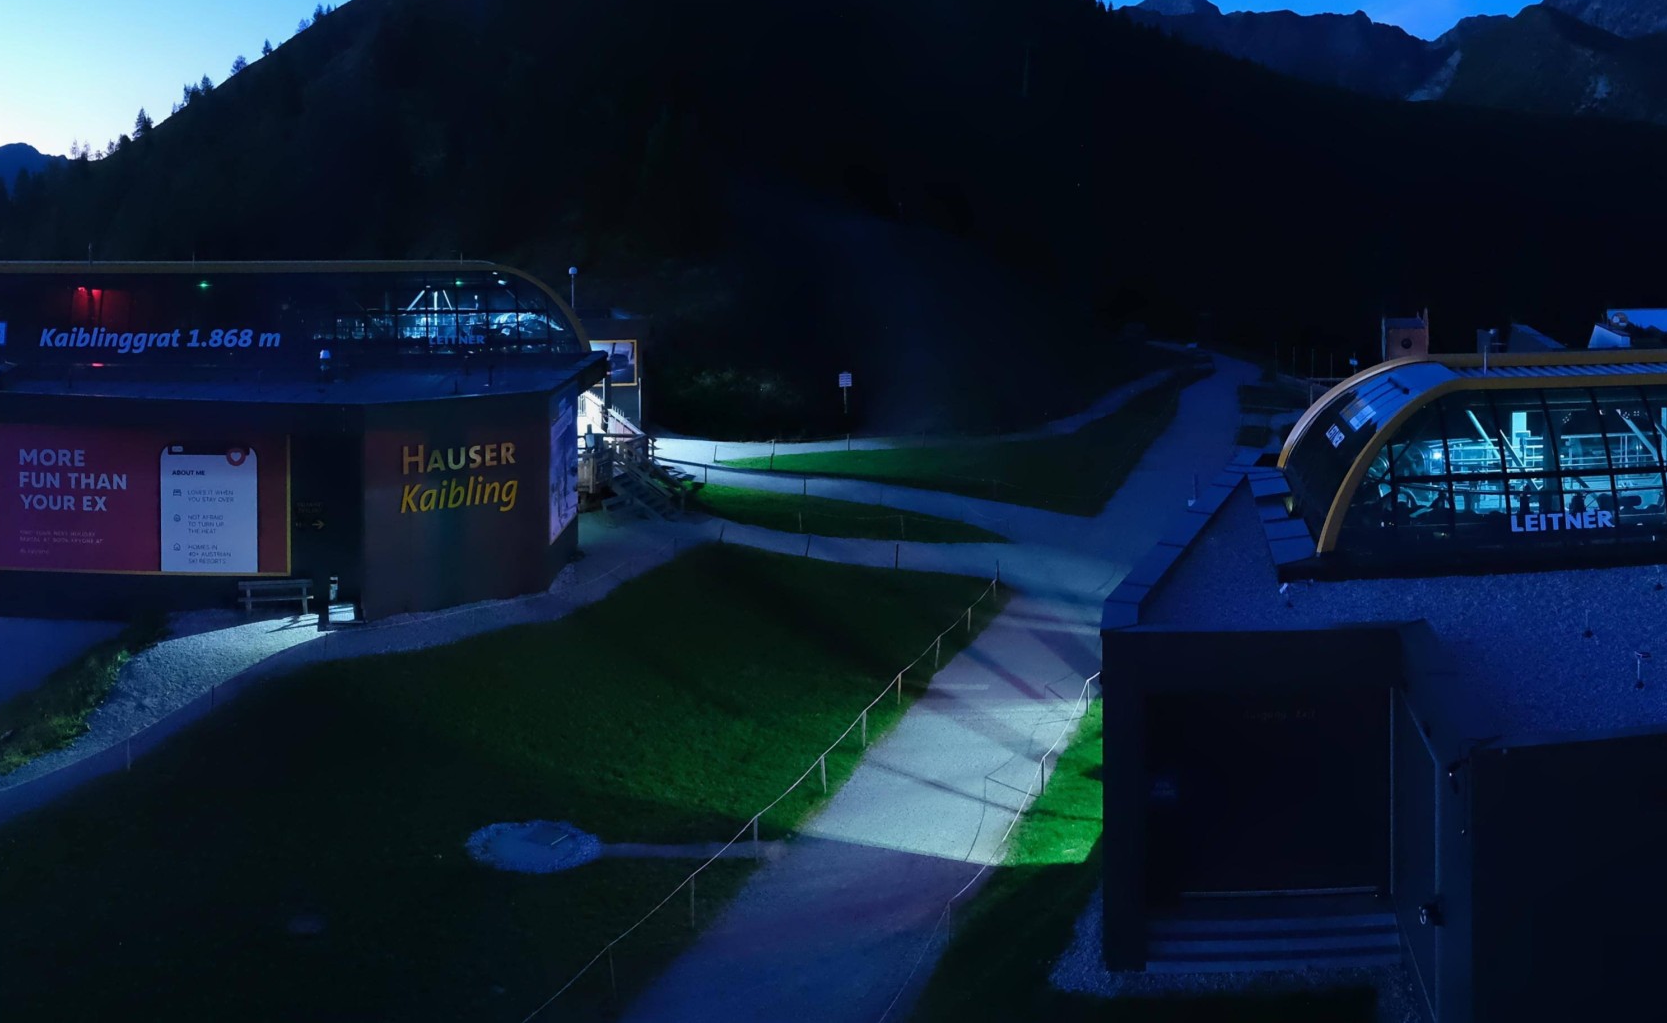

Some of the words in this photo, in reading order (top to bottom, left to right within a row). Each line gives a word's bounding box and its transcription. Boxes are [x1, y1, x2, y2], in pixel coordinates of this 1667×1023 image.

[39, 327, 181, 354] Kaiblinggrat
[186, 328, 252, 348] 1.868
[258, 332, 281, 348] m
[428, 335, 486, 345] LEITNER
[18, 448, 86, 467] MORE
[19, 471, 61, 489] FUN
[67, 472, 128, 490] THAN
[20, 494, 76, 511] YOUR
[82, 495, 108, 511] EX
[400, 475, 518, 514] Kaibling
[1510, 510, 1616, 533] LEITNER
